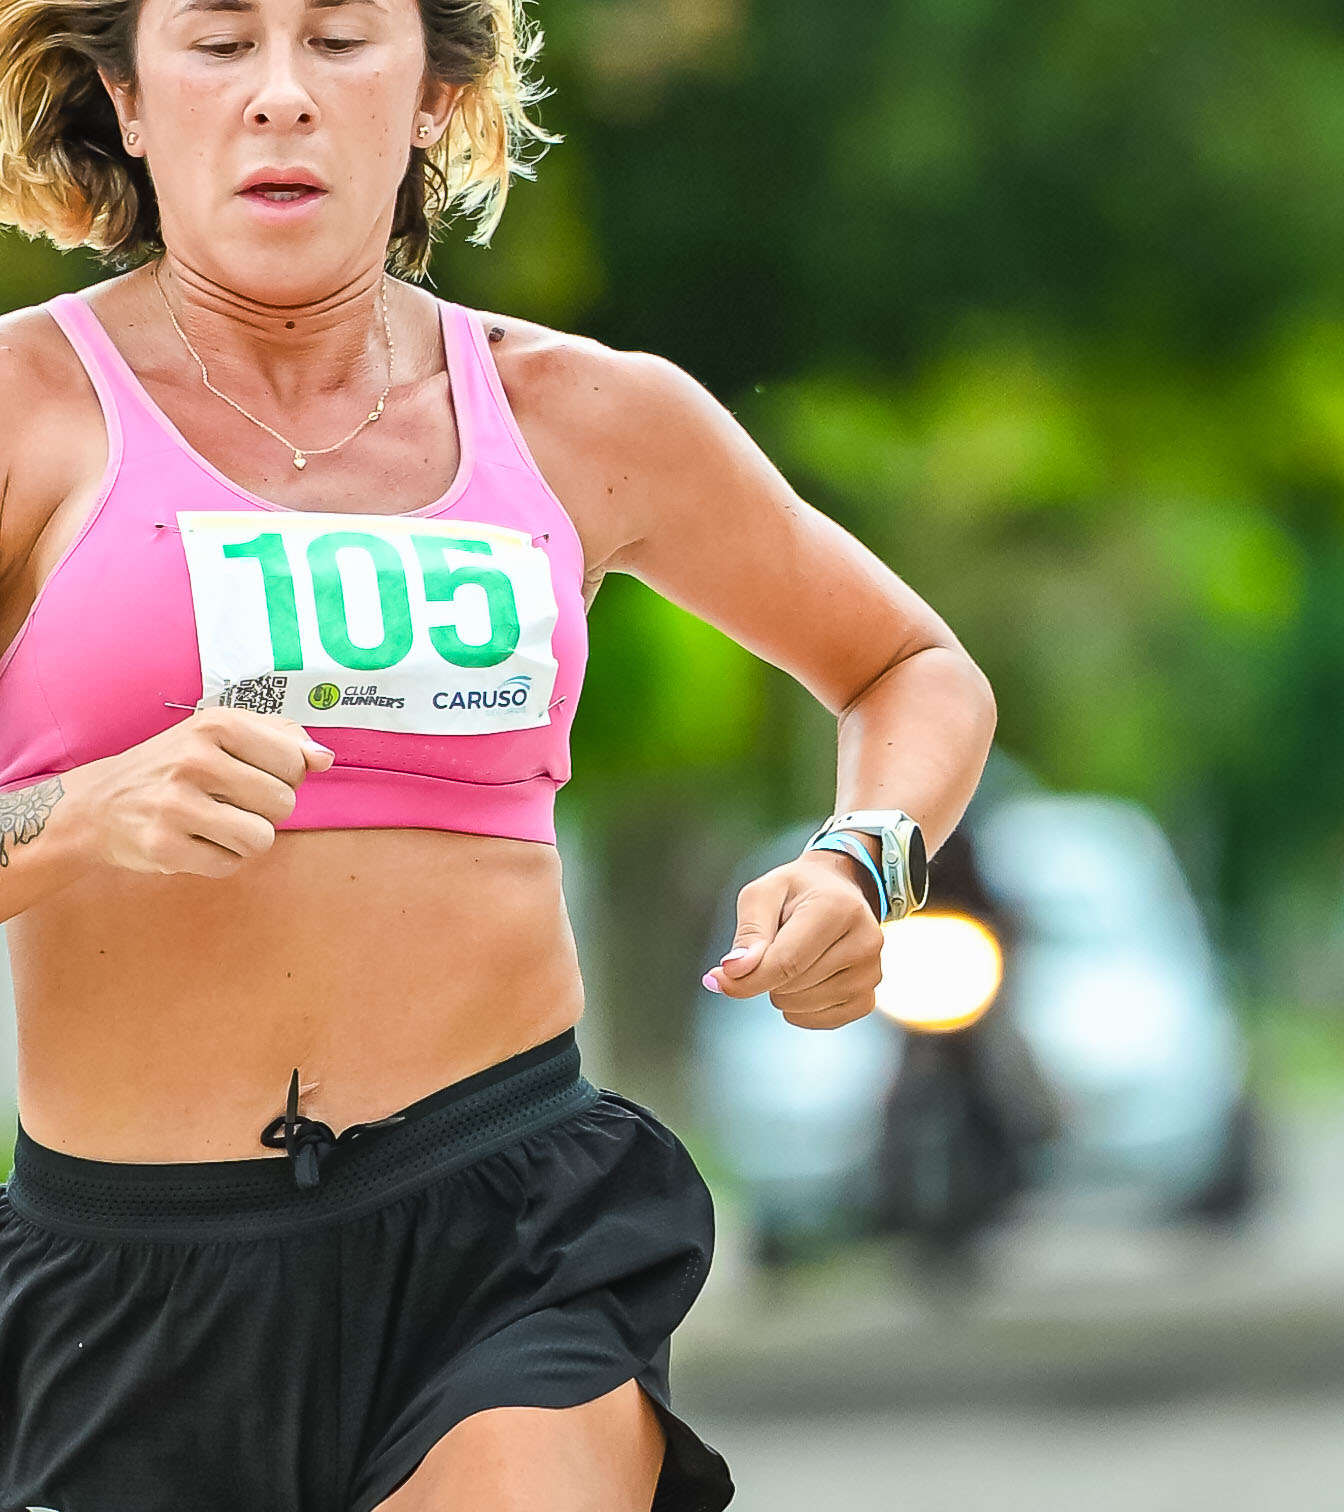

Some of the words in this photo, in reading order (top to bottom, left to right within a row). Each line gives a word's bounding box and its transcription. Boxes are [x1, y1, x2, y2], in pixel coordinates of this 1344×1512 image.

[222, 531, 521, 672] 105
[344, 685, 378, 696] CLUB
[432, 688, 528, 710] CARUSO
[341, 696, 405, 709] RUNNER'S
